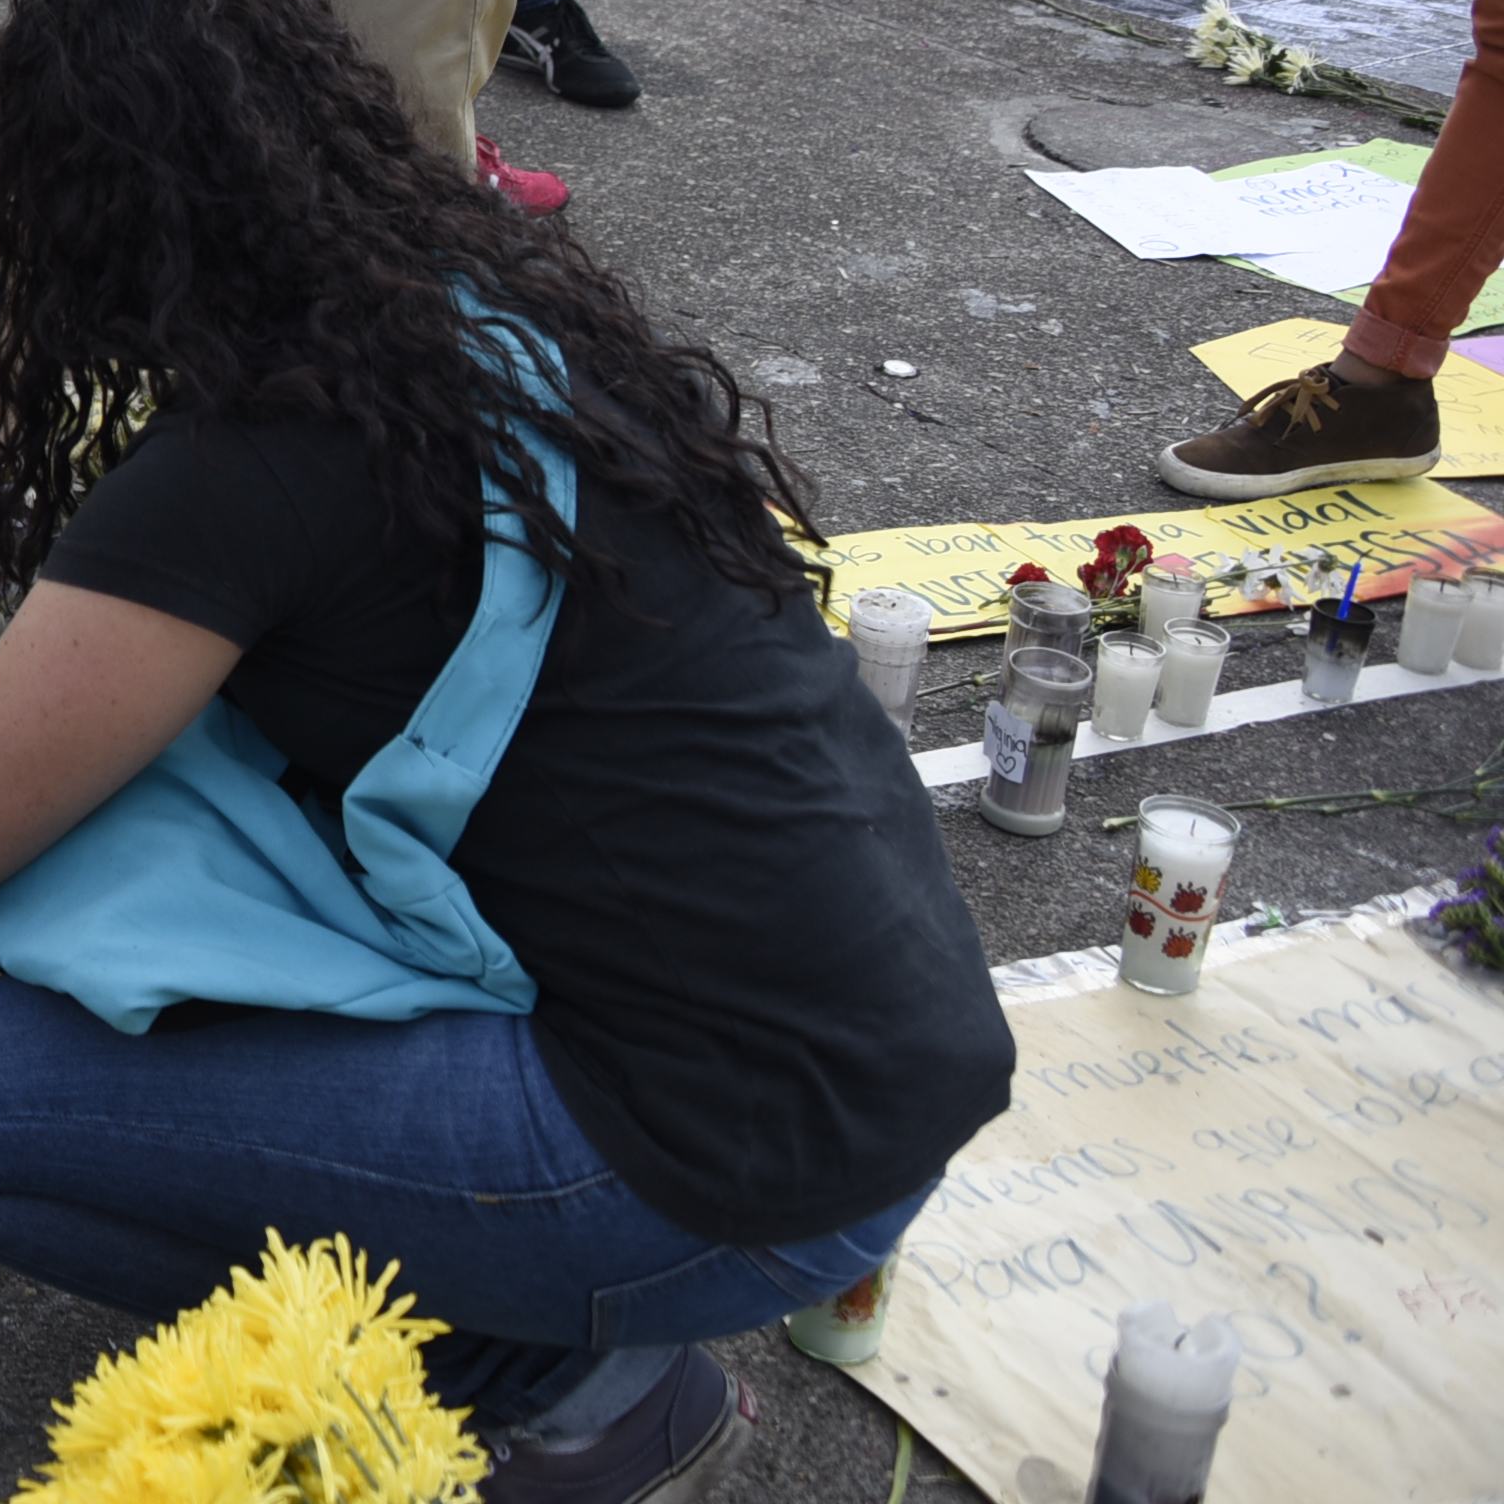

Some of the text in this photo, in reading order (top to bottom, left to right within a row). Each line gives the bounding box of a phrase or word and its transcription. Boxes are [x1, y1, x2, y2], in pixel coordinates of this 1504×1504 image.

[905, 531, 1004, 557] iban
[1020, 524, 1096, 553] tra
[1221, 489, 1397, 536] vida!
[1026, 1018, 1300, 1098] muertes
[1192, 1110, 1318, 1167] que
